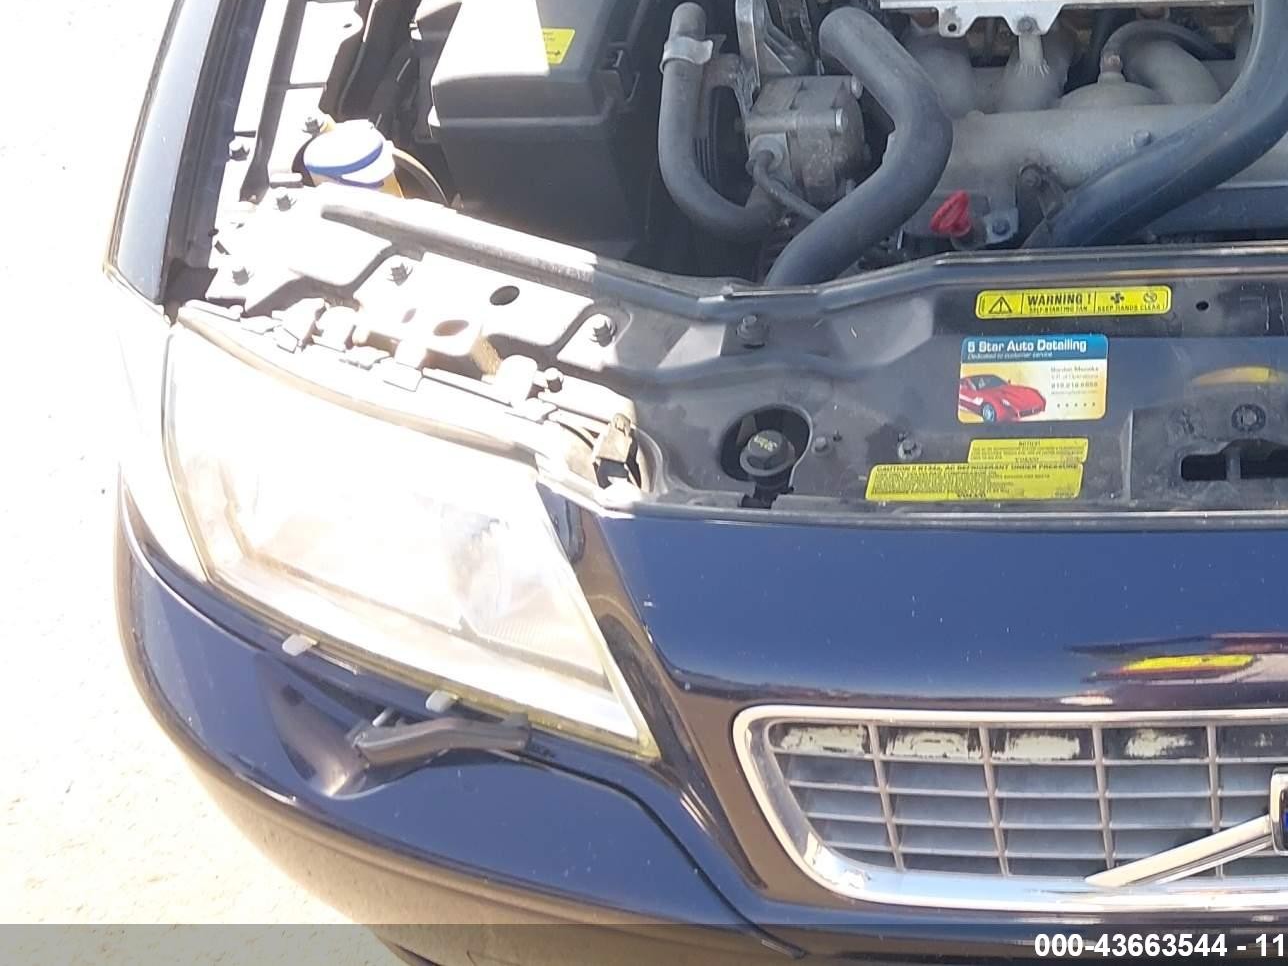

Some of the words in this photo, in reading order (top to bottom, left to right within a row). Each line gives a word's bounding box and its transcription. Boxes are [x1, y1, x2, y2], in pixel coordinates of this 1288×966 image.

[1027, 294, 1083, 306] WARNING
[1097, 305, 1114, 313] KEEP
[1140, 303, 1161, 311] CLEAR
[978, 340, 1005, 353] Star
[1006, 338, 1034, 353] Auto
[1036, 337, 1087, 353] Detailing
